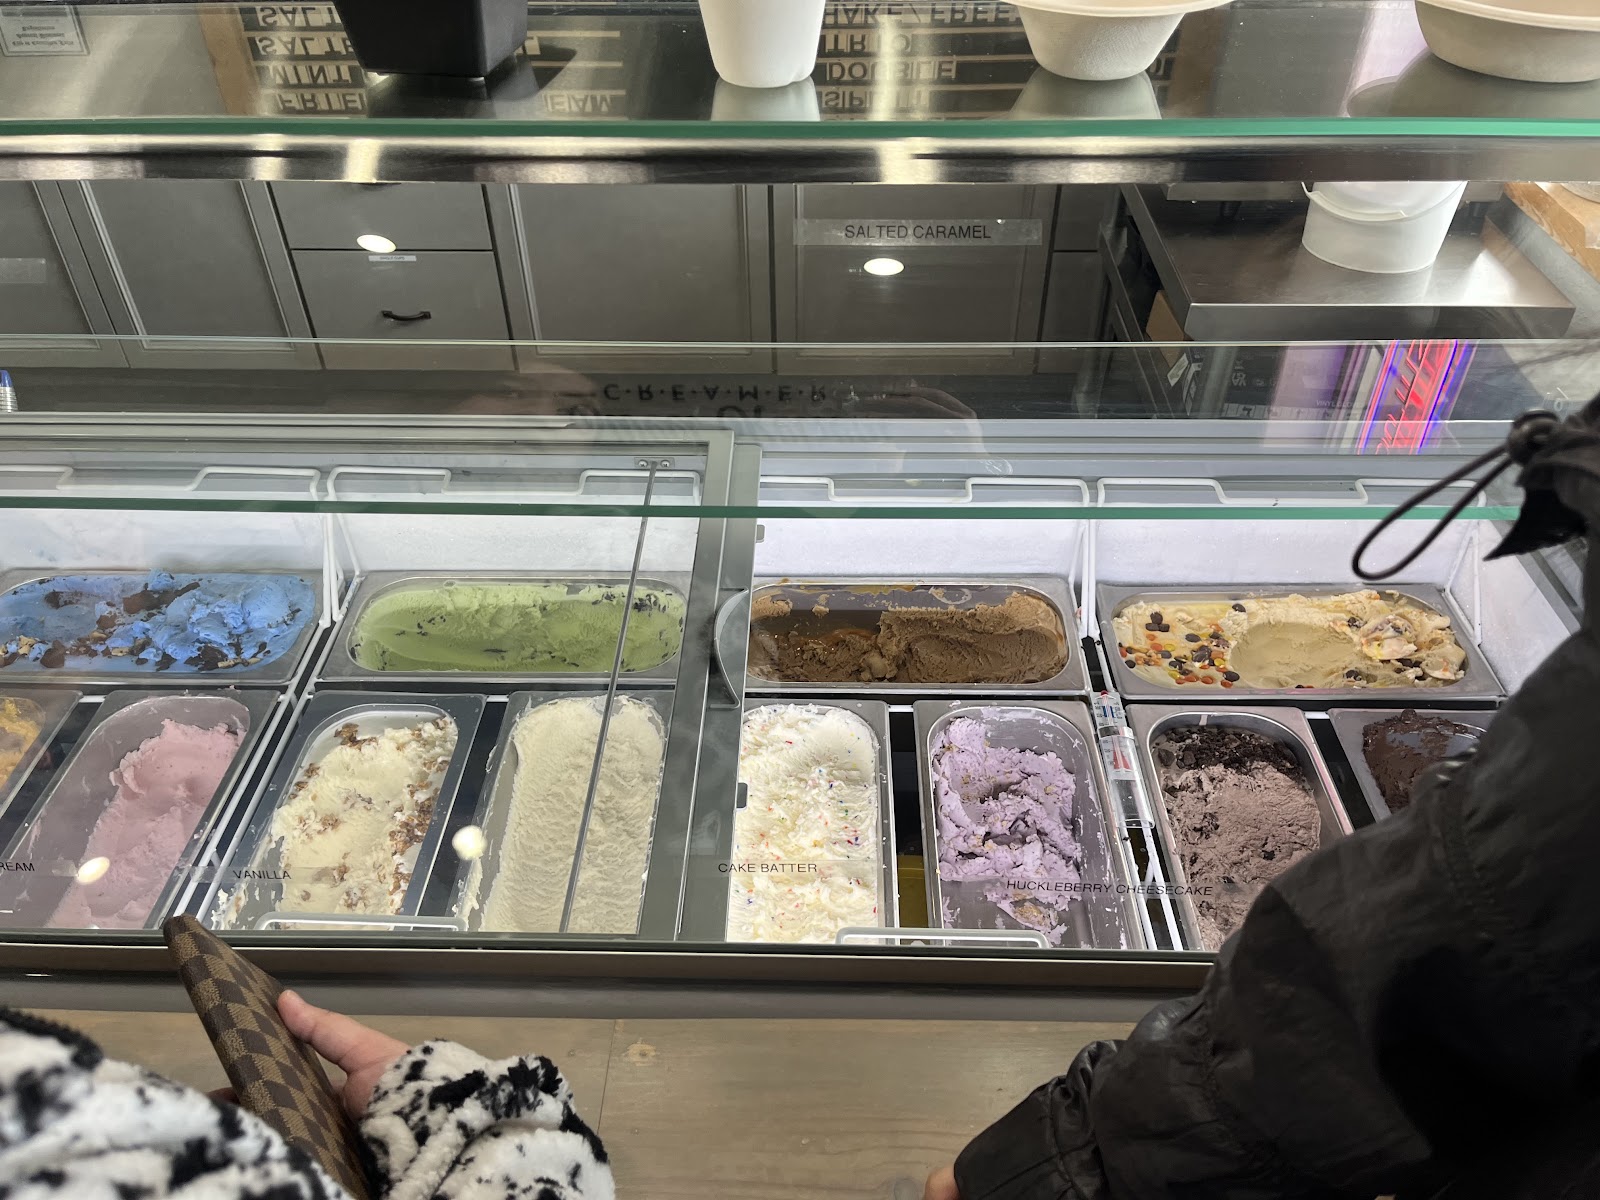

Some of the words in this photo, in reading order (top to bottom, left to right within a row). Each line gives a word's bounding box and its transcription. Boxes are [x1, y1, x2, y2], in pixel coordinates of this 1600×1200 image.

[845, 225, 908, 239] SALTED
[913, 225, 991, 239] CARAMEL
[0, 862, 35, 872] REAM
[718, 863, 756, 873] CAKE
[761, 863, 817, 873] BATTER
[232, 869, 292, 881] VANILLA
[1006, 880, 1112, 893] HUCKLEBERRY
[1116, 884, 1213, 896] CHEESECAKE
